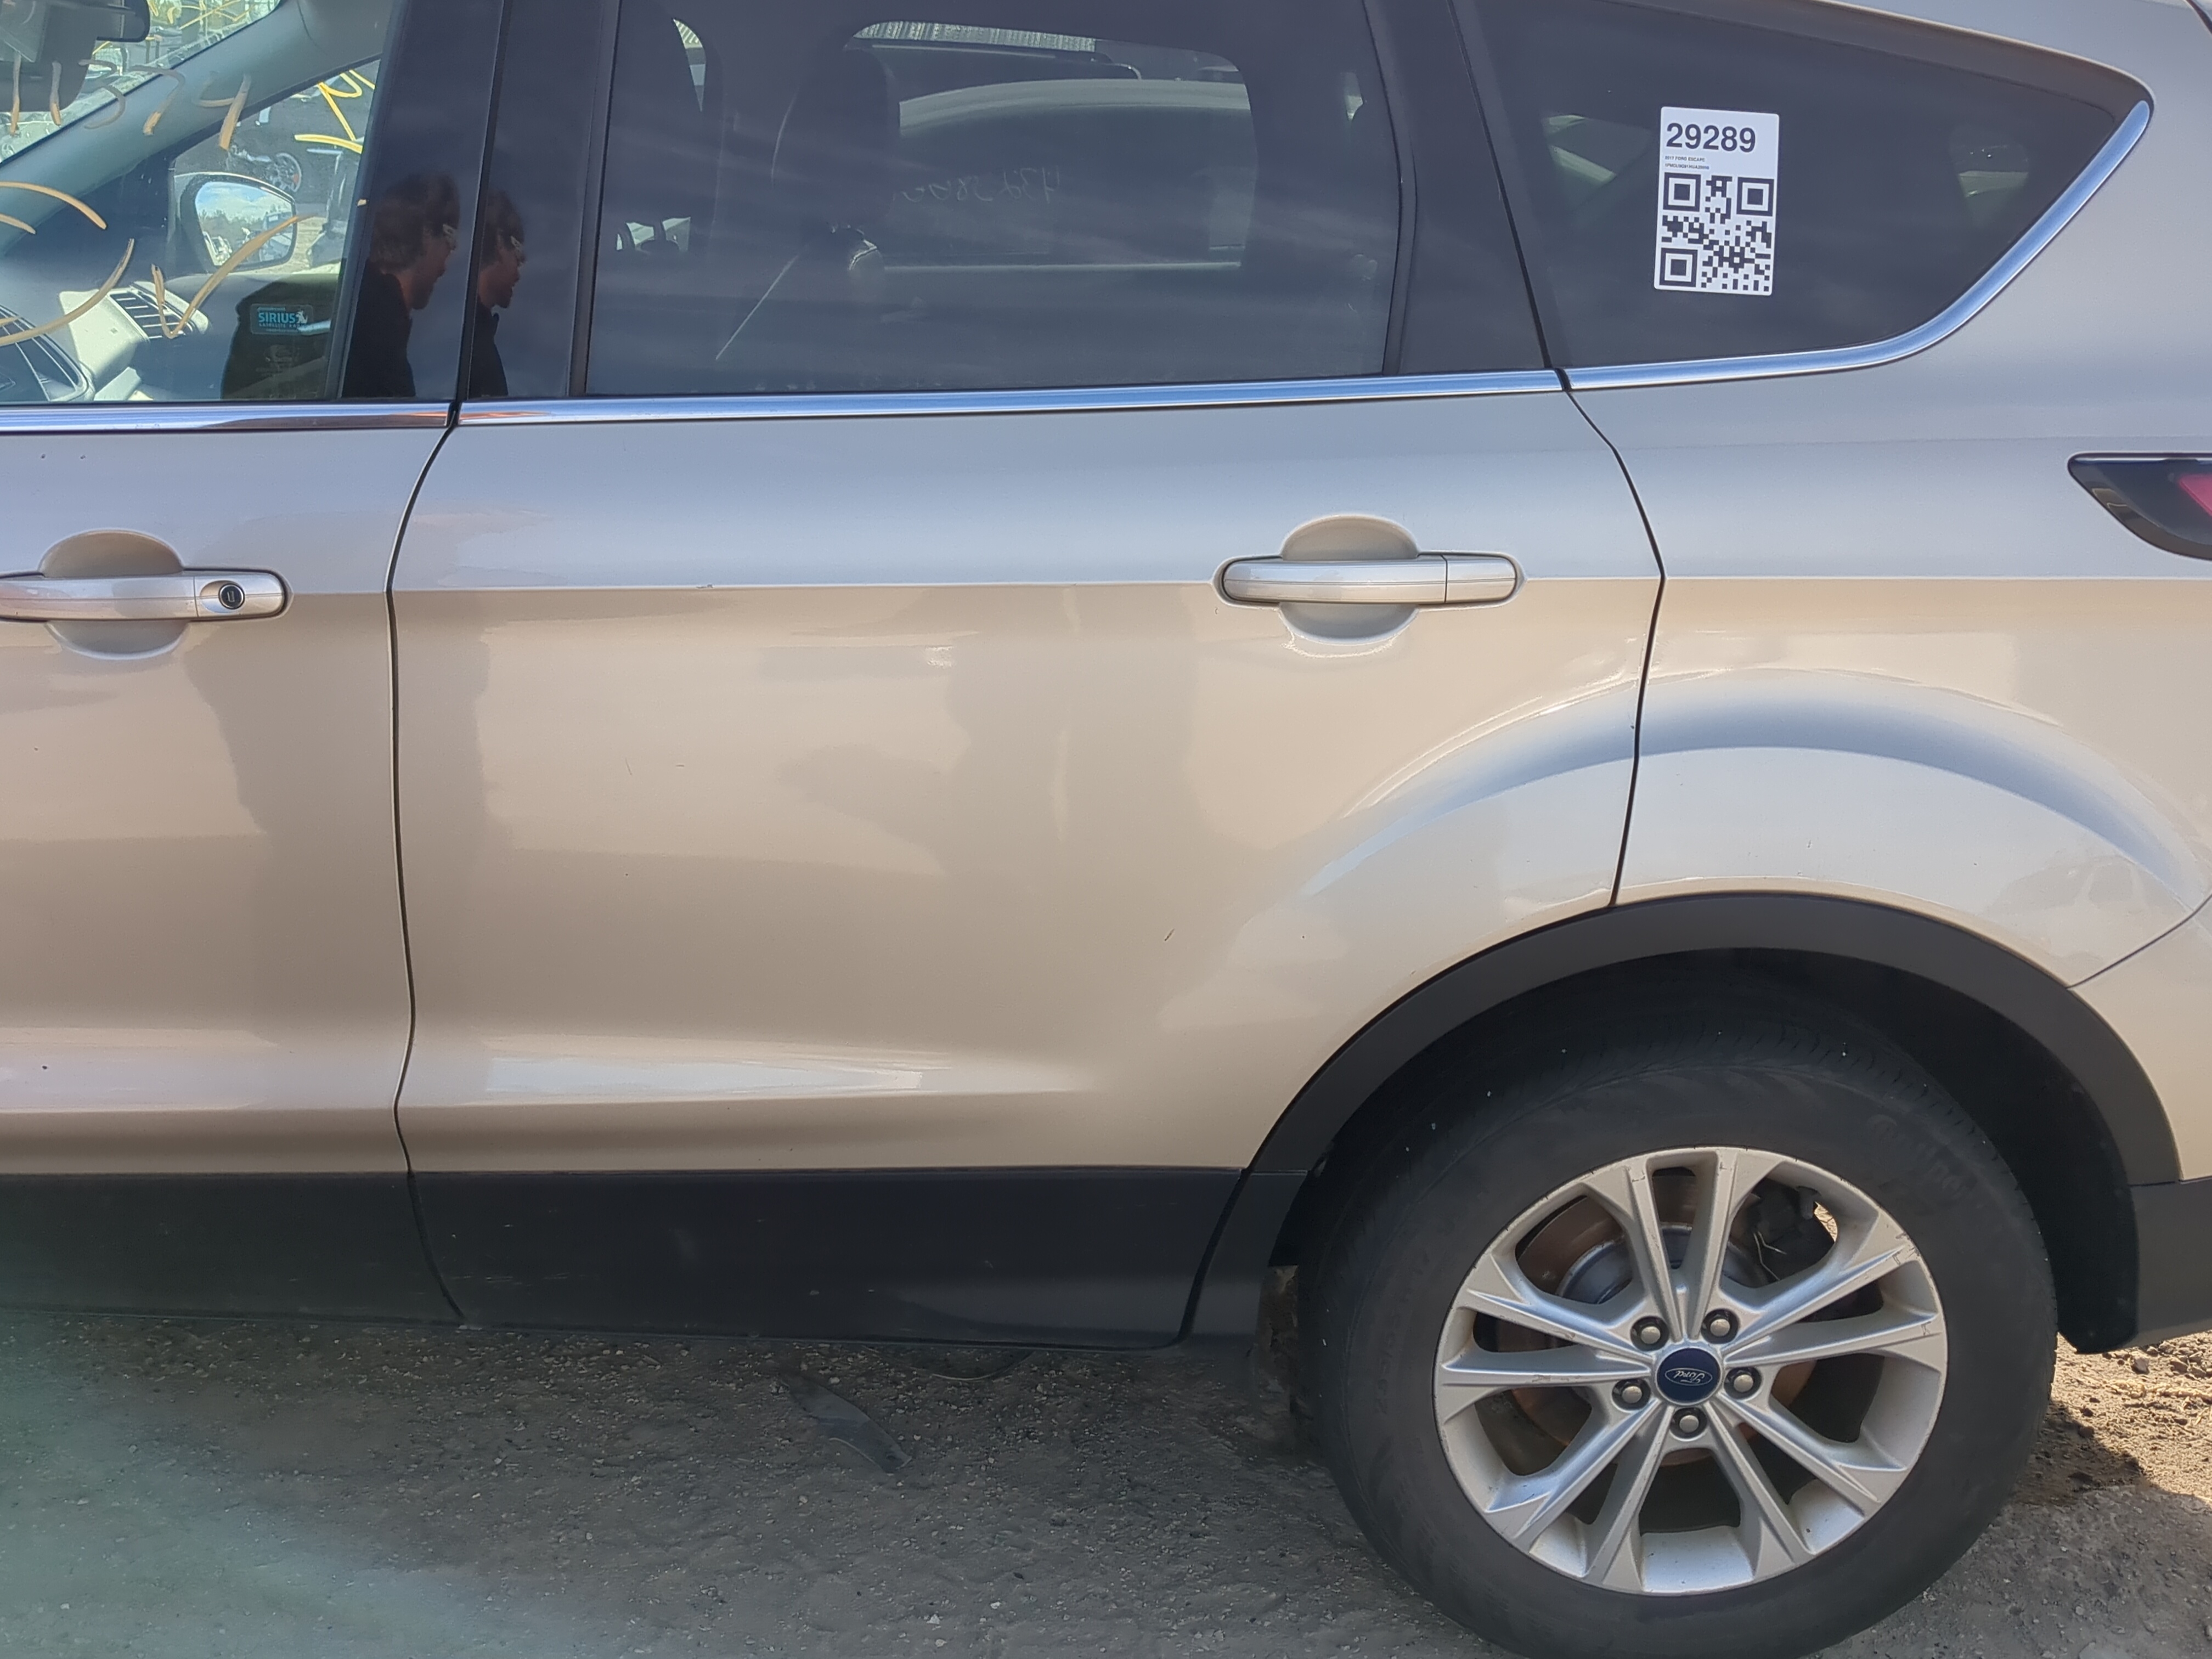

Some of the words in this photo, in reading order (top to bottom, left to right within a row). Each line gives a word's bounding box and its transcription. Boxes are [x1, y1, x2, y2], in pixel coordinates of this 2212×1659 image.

[1666, 122, 1756, 153] 29289
[258, 312, 296, 324] SIRIUS
[1673, 1370, 1705, 1384] Ford
